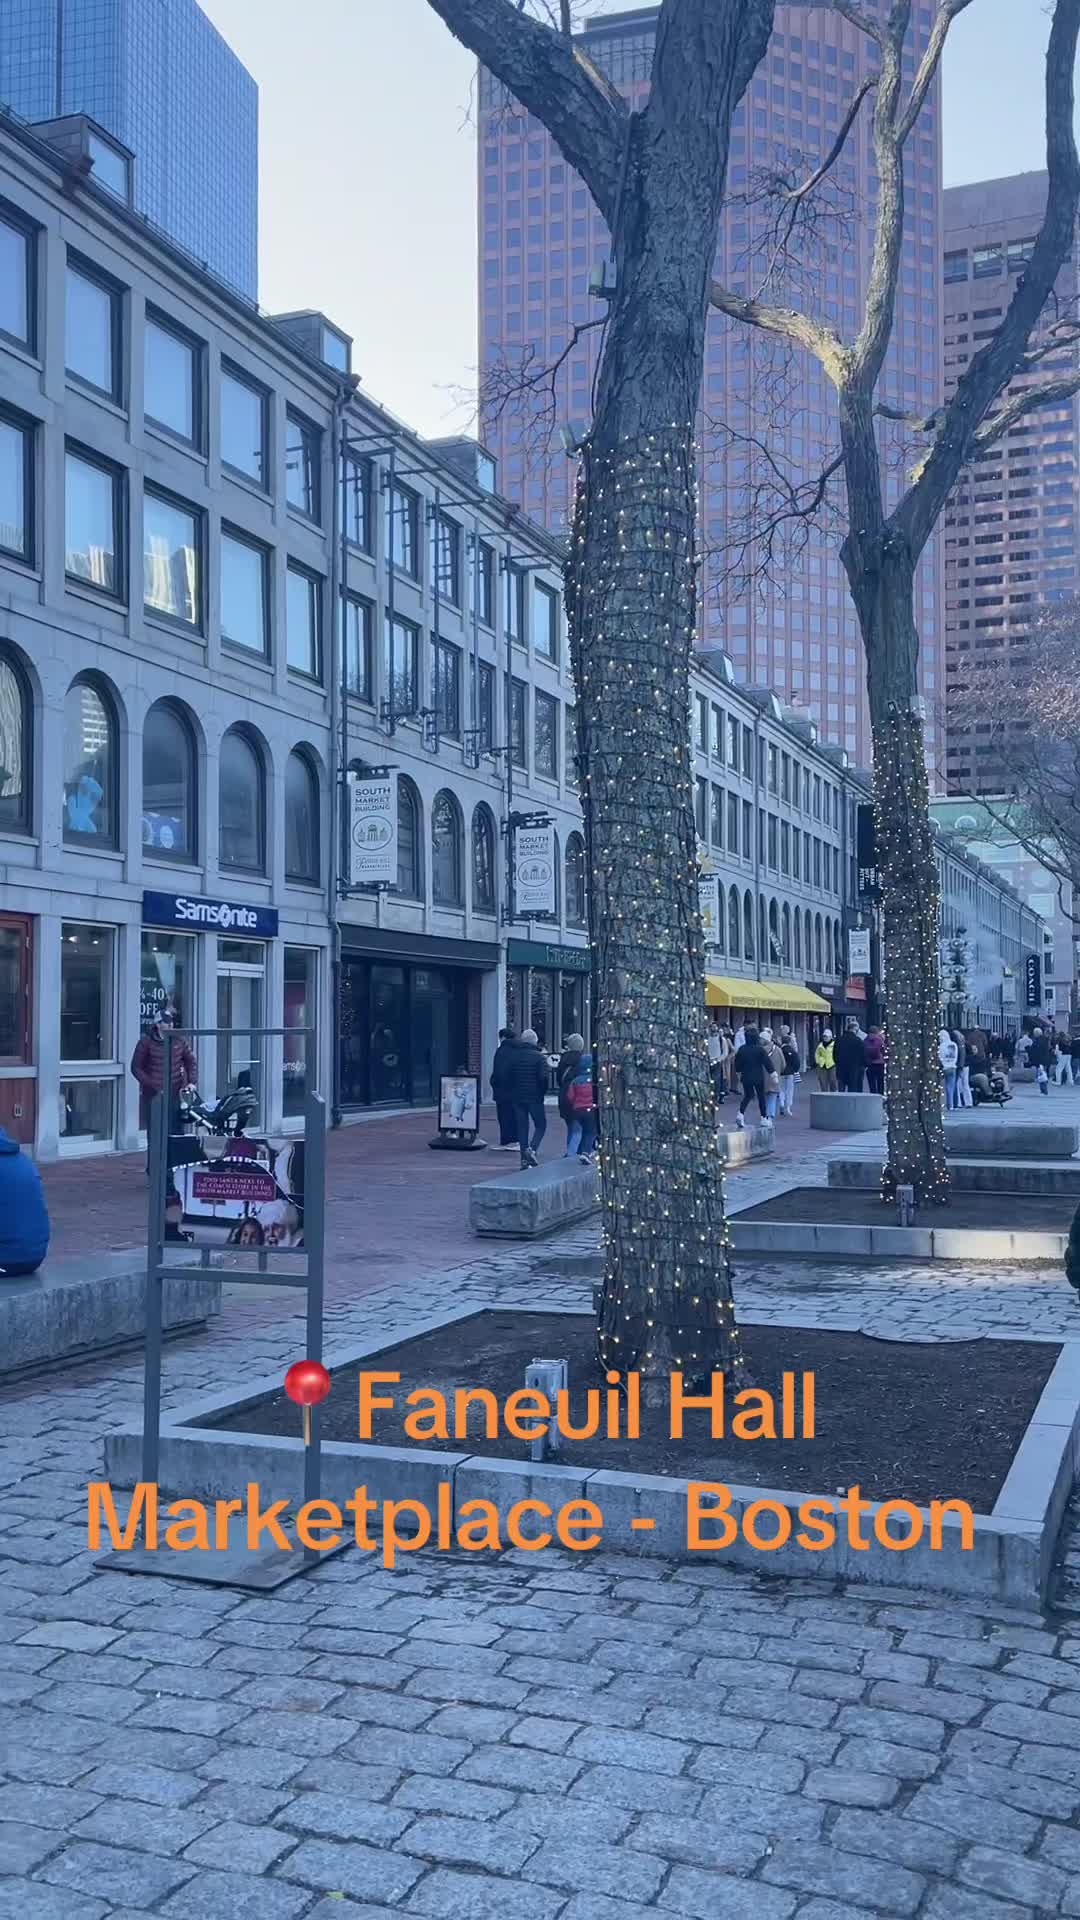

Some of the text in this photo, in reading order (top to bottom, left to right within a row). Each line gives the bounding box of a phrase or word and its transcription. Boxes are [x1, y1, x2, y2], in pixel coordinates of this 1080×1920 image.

[355, 787, 391, 796] SOUTH
[519, 836, 549, 844] SOUTH
[175, 898, 258, 928] Samsonite
[1027, 959, 1036, 1001] COACH
